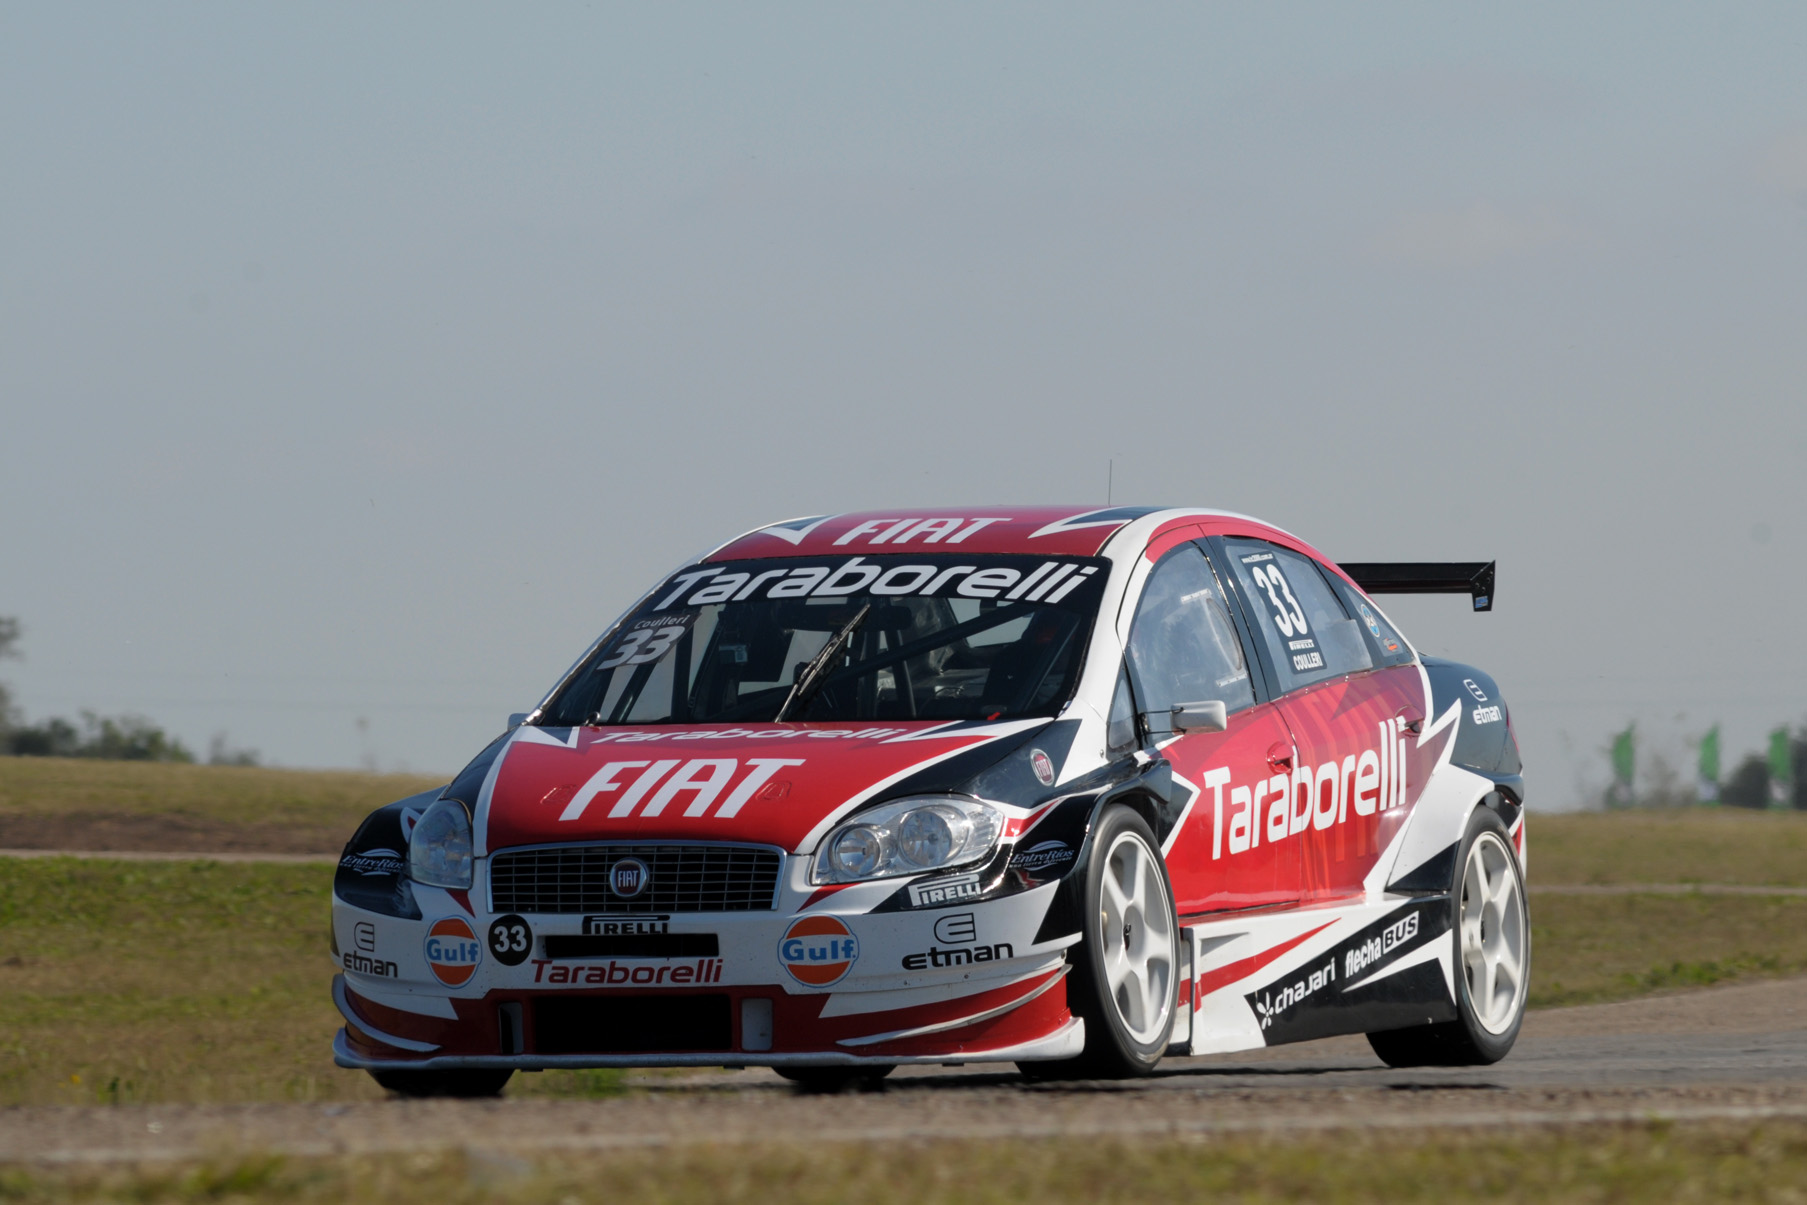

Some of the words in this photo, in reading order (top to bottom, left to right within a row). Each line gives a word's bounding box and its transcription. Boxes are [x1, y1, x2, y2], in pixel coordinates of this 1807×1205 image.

[832, 517, 1012, 545] FIAT
[653, 556, 1099, 611] Taraborelli
[1252, 564, 1308, 637] 33
[634, 615, 690, 629] Coulleri
[596, 626, 685, 670] 33
[1472, 705, 1502, 725] etman
[590, 727, 906, 744] Taraborelli
[558, 758, 806, 821] FIAT
[1203, 715, 1406, 860] Taraborelli
[617, 870, 639, 887] FIAT
[908, 873, 982, 907] PIRELLI
[582, 914, 671, 935] PIRELLI
[426, 938, 479, 962] Gulf
[494, 925, 527, 952] 33
[782, 939, 857, 962] Gulf
[343, 951, 398, 978] etman
[902, 942, 1014, 970] etman
[531, 958, 723, 984] Taraborelli
